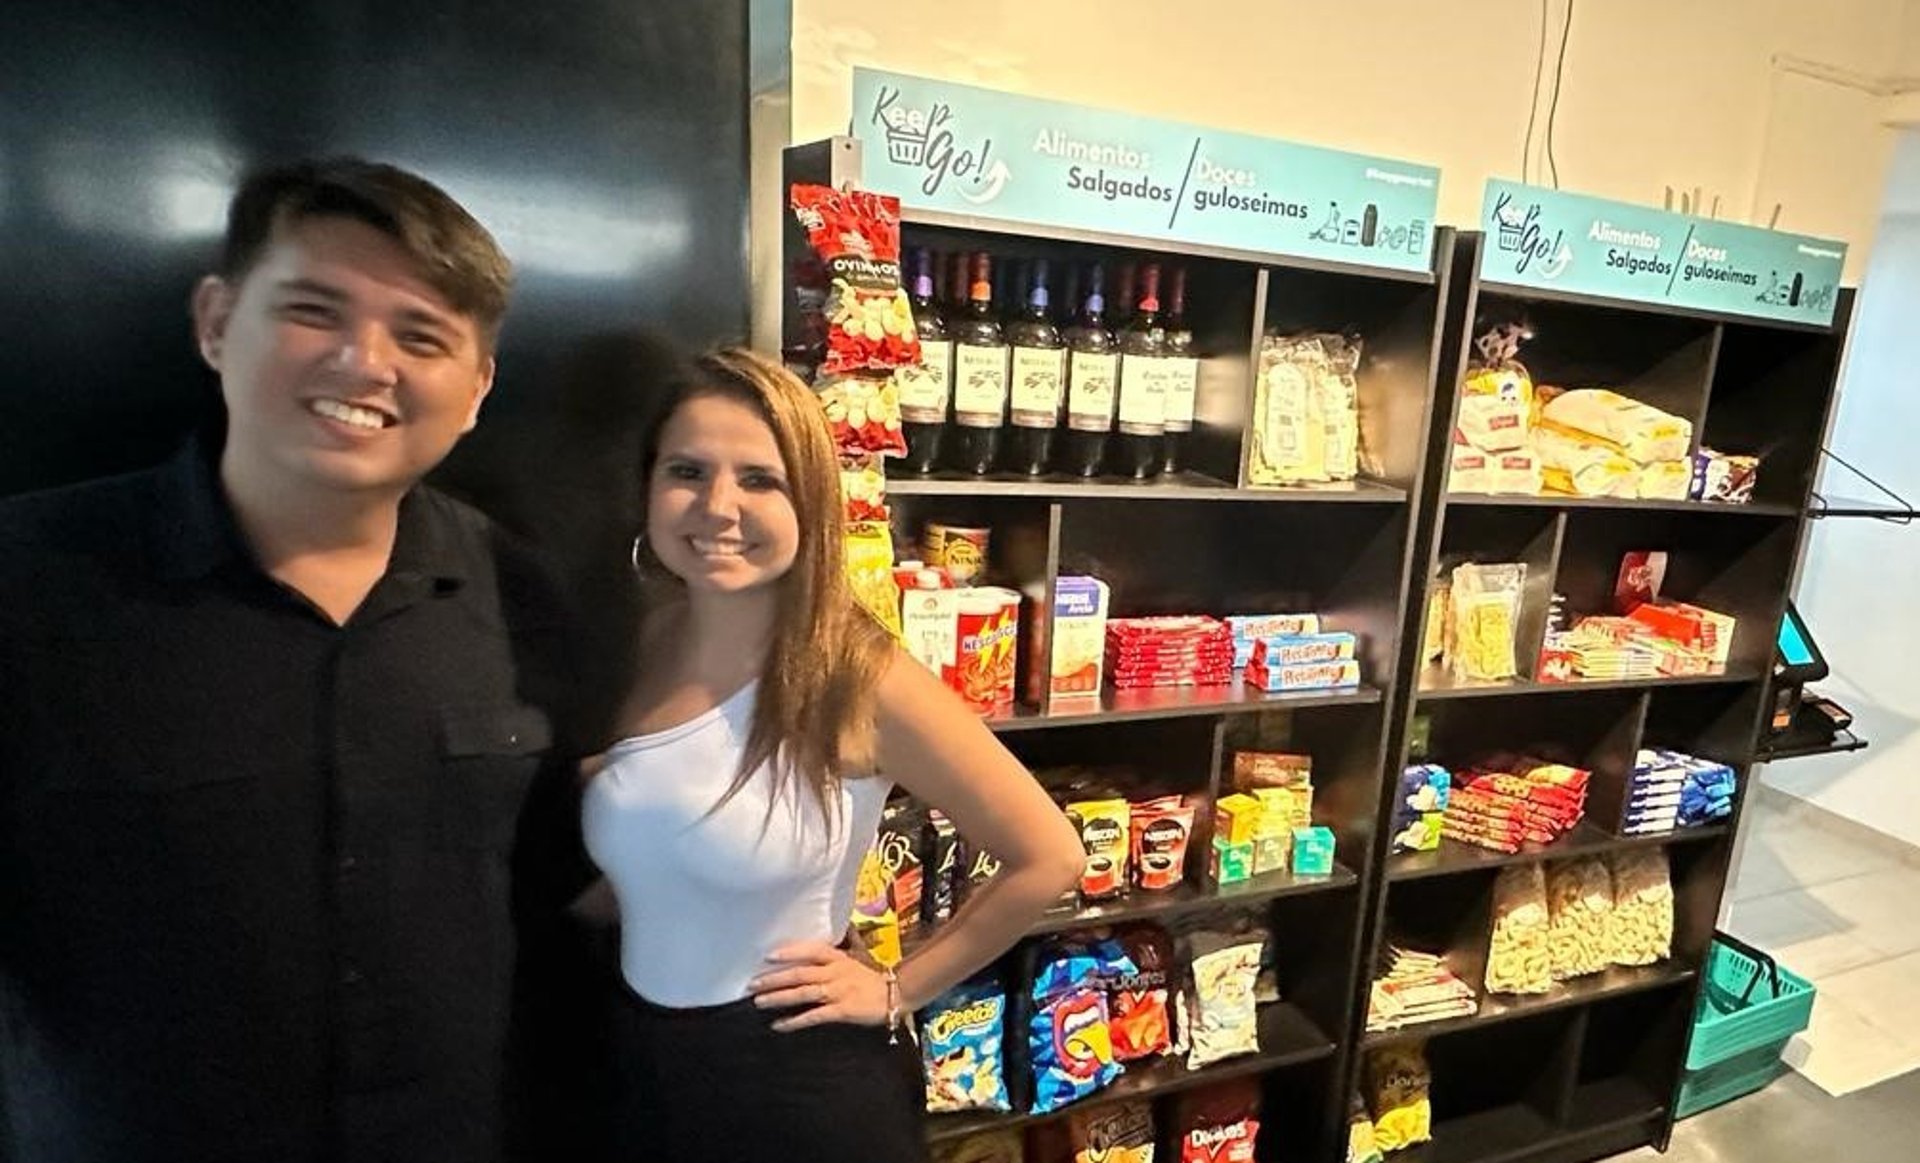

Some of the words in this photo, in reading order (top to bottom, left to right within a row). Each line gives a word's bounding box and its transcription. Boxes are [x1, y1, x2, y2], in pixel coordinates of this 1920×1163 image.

[1032, 127, 1151, 168] Alimentos
[921, 130, 990, 196] Go!
[1197, 158, 1257, 188] Doces
[1066, 165, 1174, 203] Salgados
[1193, 185, 1309, 220] guloseimas
[1514, 223, 1563, 275] Go!
[1588, 220, 1662, 250] Alimentos
[1686, 236, 1728, 263] Doces
[1605, 248, 1672, 276] Salgados
[1683, 260, 1758, 287] guloseimas
[950, 552, 985, 566] NINH
[931, 1000, 997, 1041] Cheetos
[1191, 1118, 1248, 1148] Doritos
